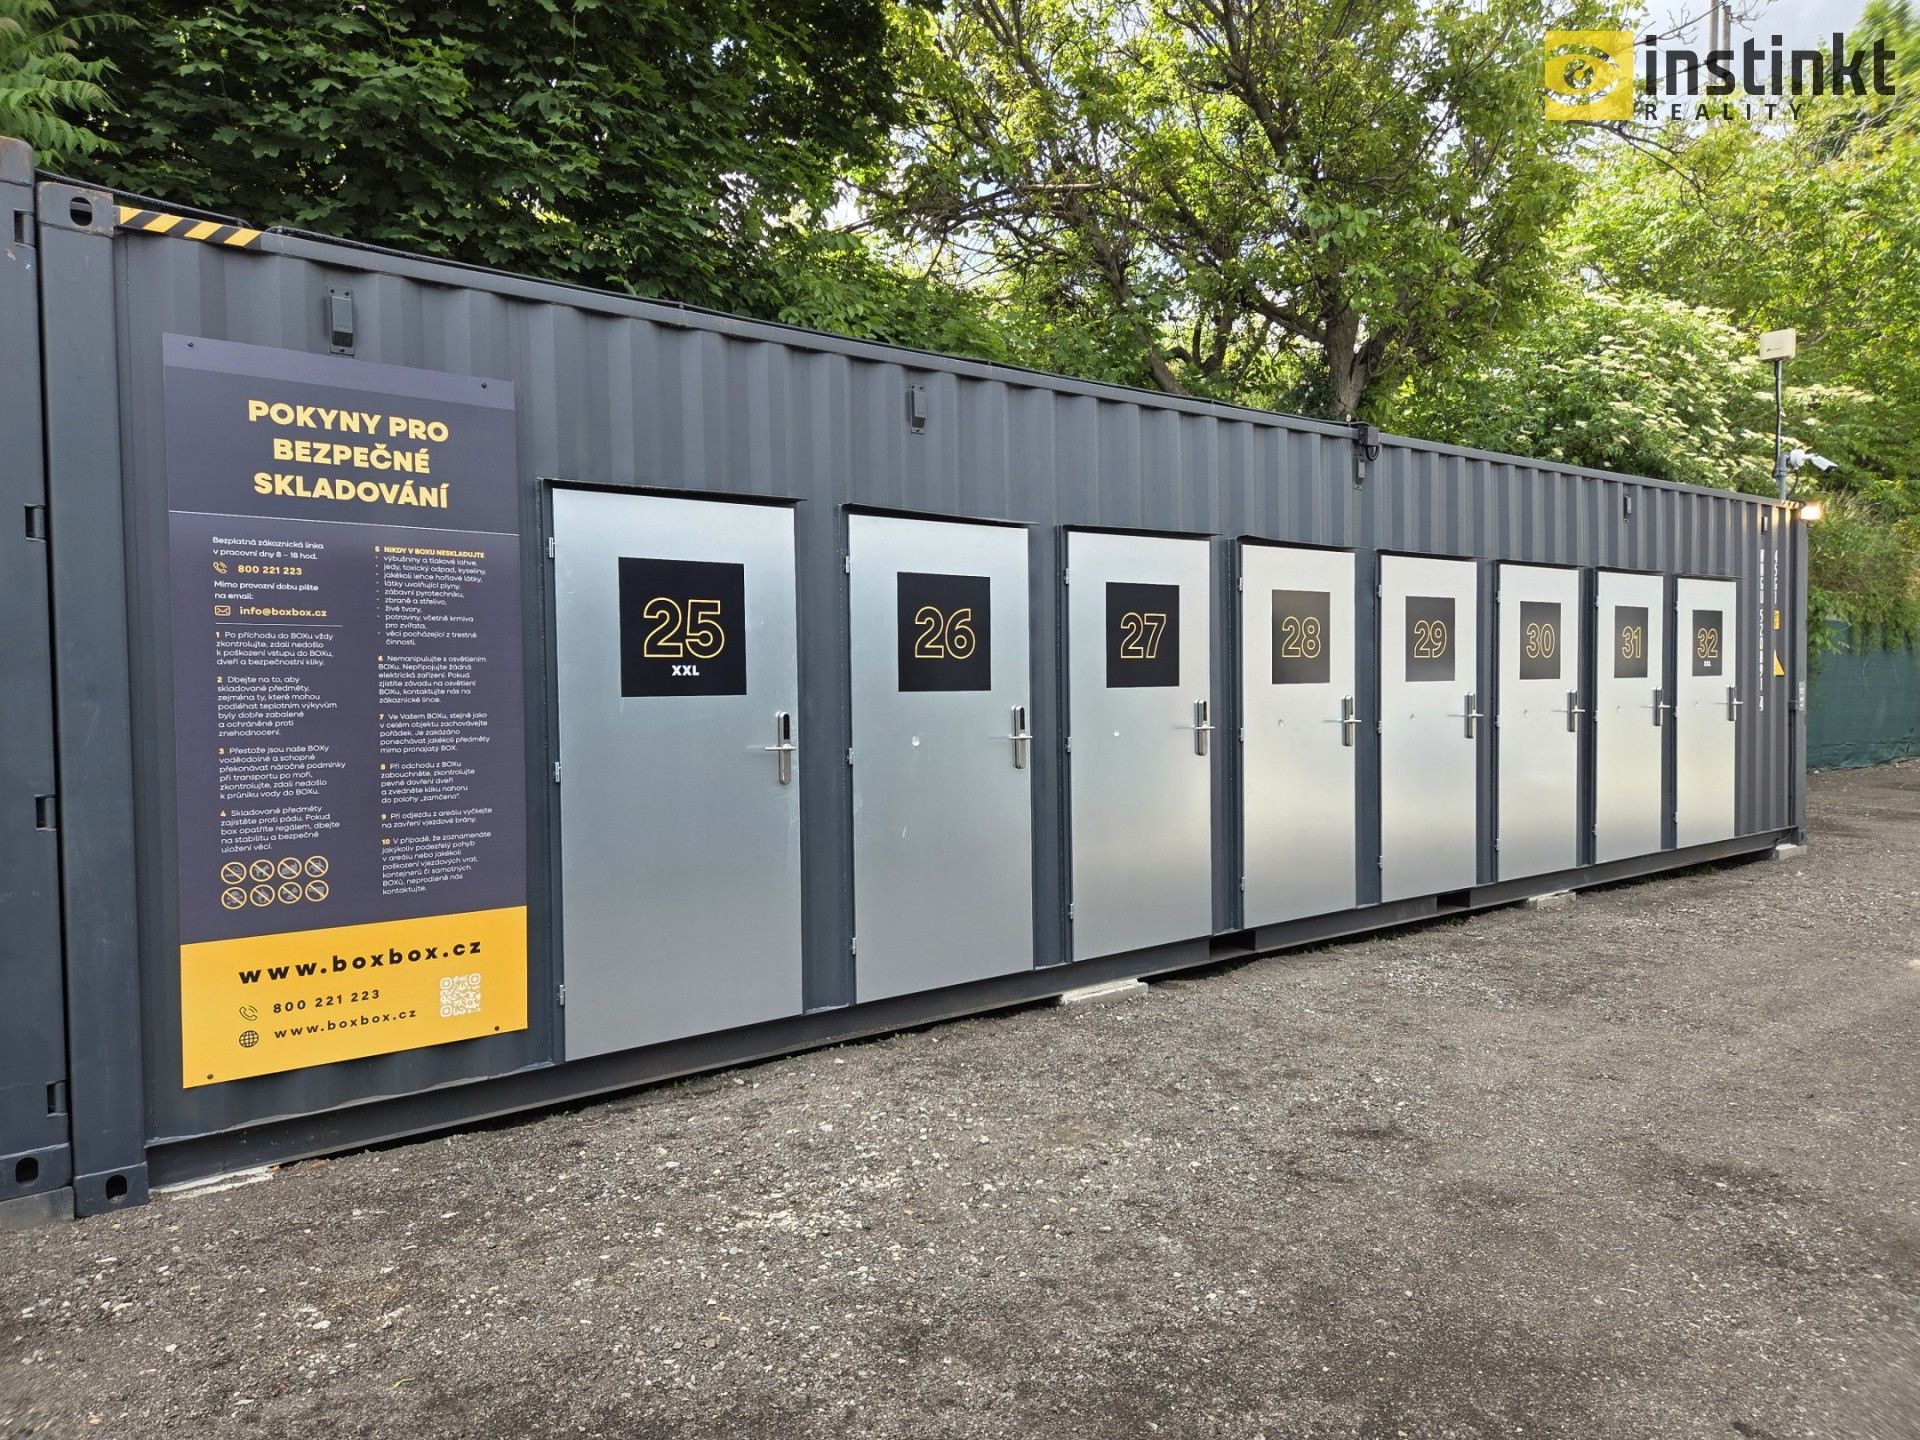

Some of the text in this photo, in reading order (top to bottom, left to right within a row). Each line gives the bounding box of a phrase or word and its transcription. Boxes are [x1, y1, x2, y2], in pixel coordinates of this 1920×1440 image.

[248, 399, 449, 443] POKYNY PRO
[273, 438, 430, 474] BEZPEČNÉ
[254, 472, 449, 508] SKLADOVÁNÍ
[212, 536, 324, 549] Bezplatná zákaznická linka
[219, 547, 257, 558] pracovní
[258, 549, 275, 559] dny
[275, 550, 281, 558] 8
[213, 579, 319, 592] Mimo provozní dobu pište
[237, 564, 302, 575] 800 221 223
[227, 591, 254, 599] email:
[239, 606, 327, 618] info@boxbox.cz
[643, 597, 725, 658] 25
[915, 606, 976, 659] 26
[1121, 612, 1166, 659] 27
[1281, 616, 1321, 658] 28
[1413, 619, 1447, 659] 29
[1525, 623, 1555, 659] 30
[1621, 626, 1642, 659] 31
[1697, 628, 1718, 659] 32
[671, 664, 700, 677] XXL
[238, 940, 481, 984] www.boxbox.cz
[273, 988, 380, 1014] 800 221 223
[273, 1009, 417, 1039] www.boxbox.cz
